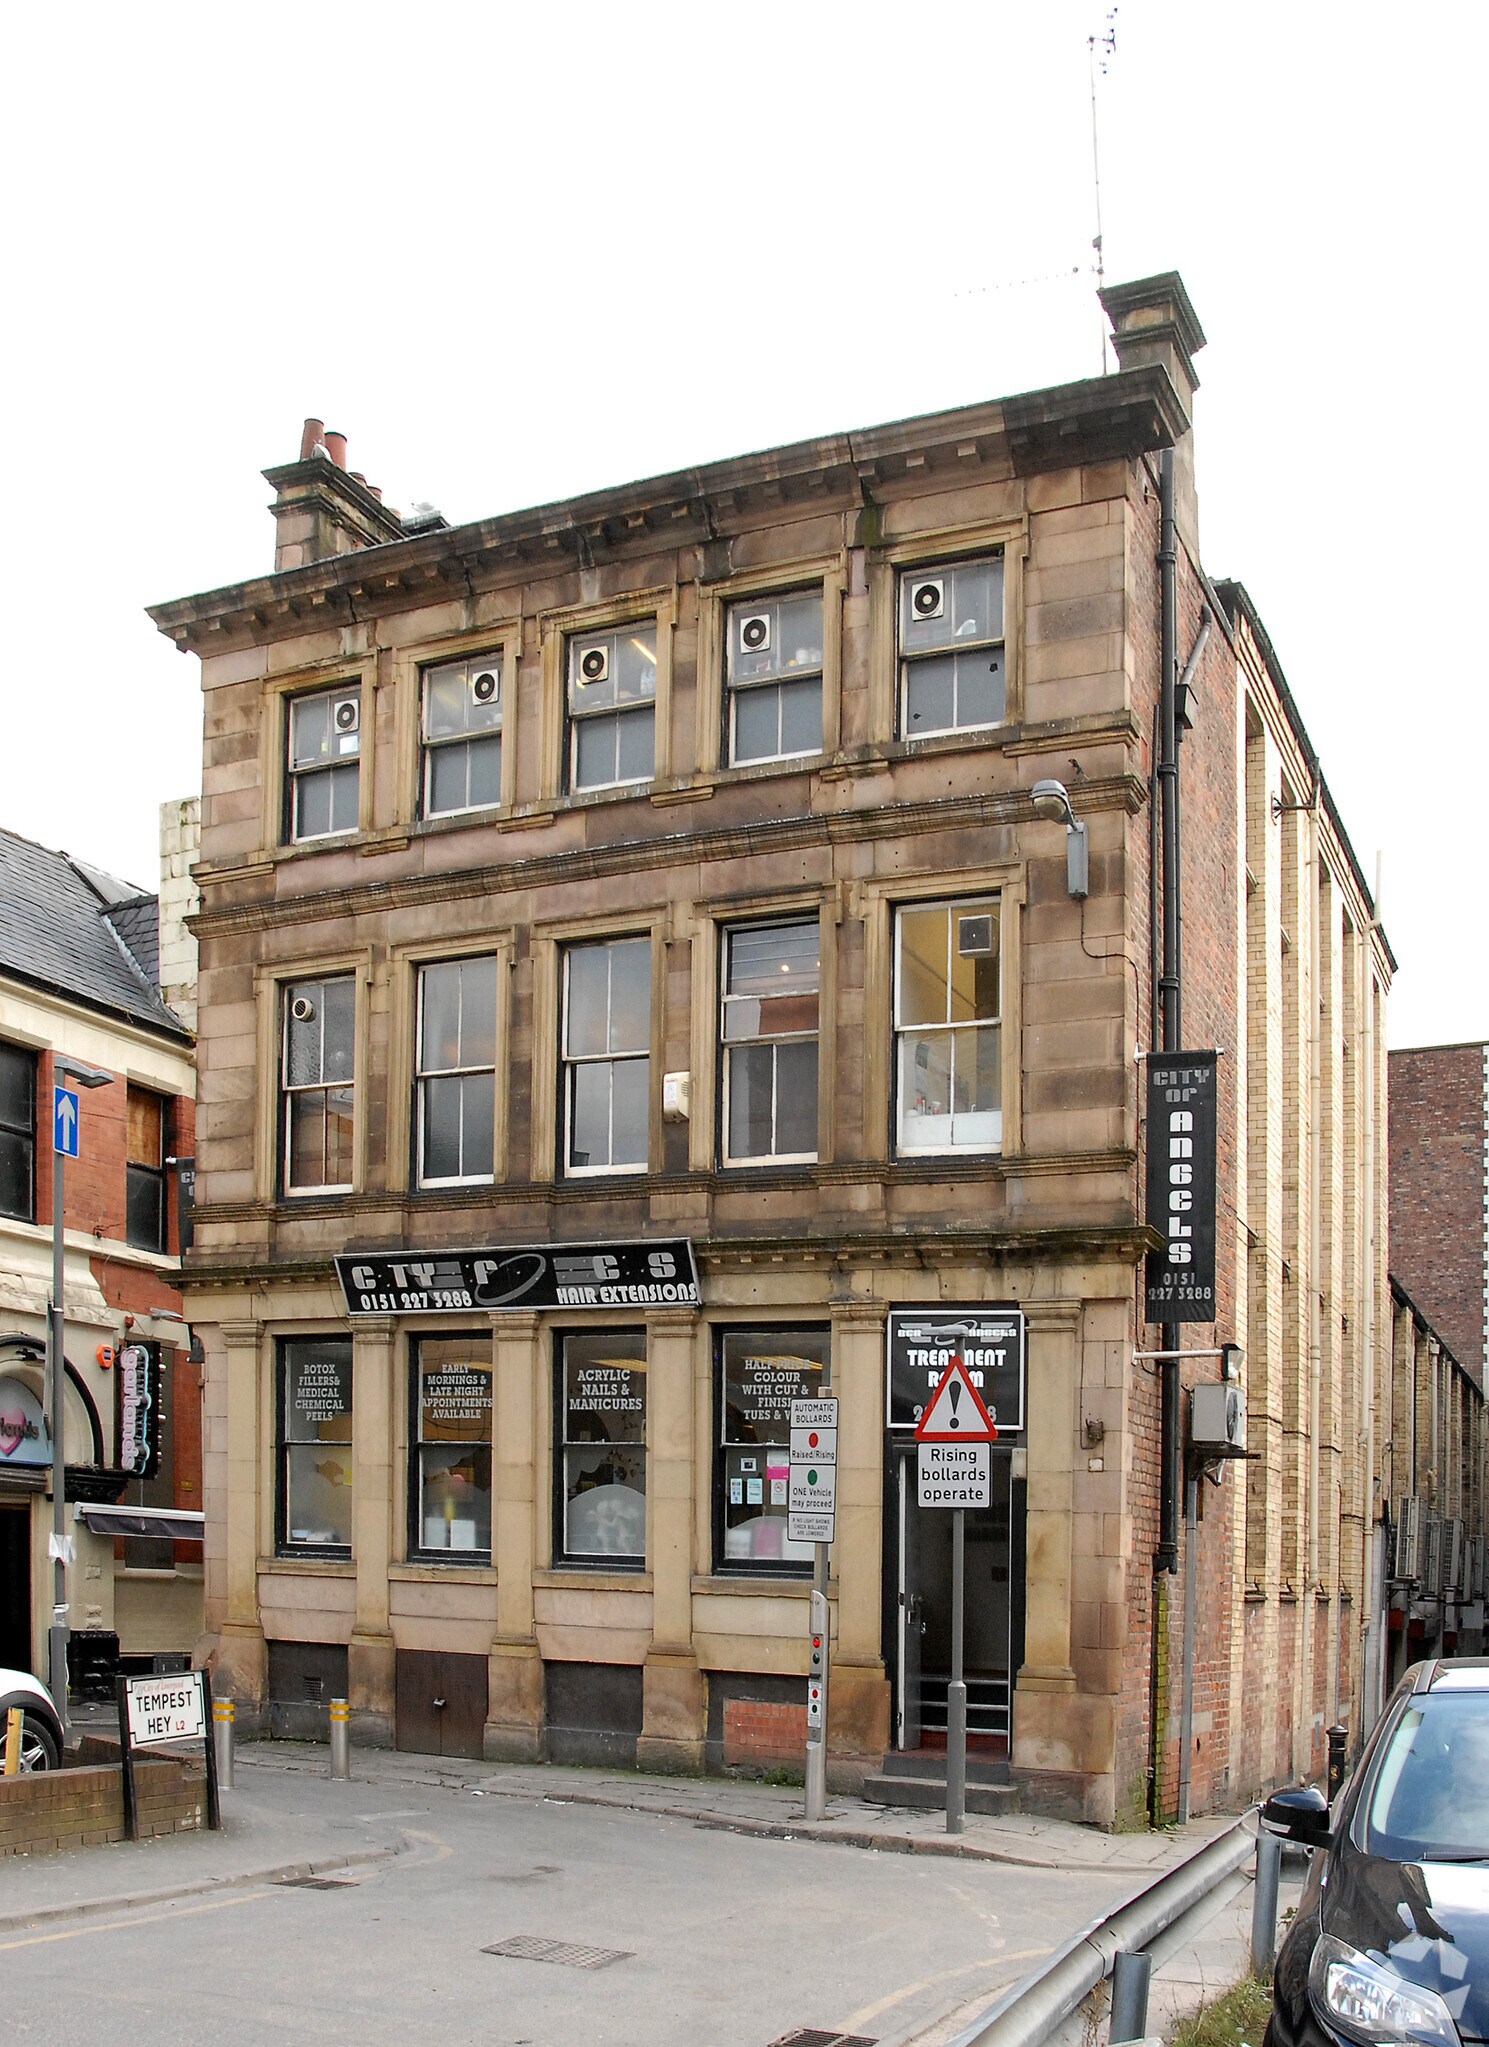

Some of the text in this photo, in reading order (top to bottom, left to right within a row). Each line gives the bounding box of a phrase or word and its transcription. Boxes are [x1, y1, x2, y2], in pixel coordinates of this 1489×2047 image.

[1153, 1069, 1210, 1086] CITY
[1165, 1087, 1197, 1103] OF
[1168, 1111, 1193, 1264] ANGELS
[1163, 1273, 1195, 1286] 0151
[556, 1282, 697, 1304] HAIR EXTENSIONS
[1148, 1286, 1212, 1300] 227 3288
[360, 1290, 472, 1310] 0151 227 3288
[906, 1349, 1007, 1367] TREAMENT
[303, 1364, 336, 1374] BOTOX
[442, 1364, 469, 1374] EARLY
[744, 1359, 773, 1370] HALF
[427, 1375, 487, 1385] MORNINGS &
[577, 1369, 631, 1381] ACRYLIC
[753, 1371, 801, 1383] COLOUR
[927, 1370, 985, 1388] RM
[297, 1388, 340, 1398] MEDICAL
[430, 1387, 484, 1396] LATE NIGHT
[581, 1383, 630, 1396] NAILS &
[742, 1384, 809, 1396] WITH CUT &
[120, 1347, 141, 1471] garlands
[295, 1399, 345, 1409] CHEMICAL
[423, 1398, 493, 1408] APPOINTMENTS
[569, 1398, 643, 1410] MANICURES
[794, 1403, 835, 1412] AUTOMATIC
[306, 1411, 333, 1421] PEELS
[432, 1409, 481, 1419] AVAILABLE
[743, 1409, 771, 1420] TUES
[773, 1410, 782, 1420] &
[795, 1414, 833, 1424] BOLLARDS
[791, 1450, 836, 1460] Raised/Rising
[931, 1448, 977, 1464] Rising
[921, 1467, 986, 1481] bollards
[792, 1487, 832, 1497] ONE Vehicle
[923, 1487, 984, 1502] operate
[791, 1500, 832, 1509] may proceed
[136, 1690, 193, 1712] TEMPEST
[147, 1716, 186, 1735] HEY L2
